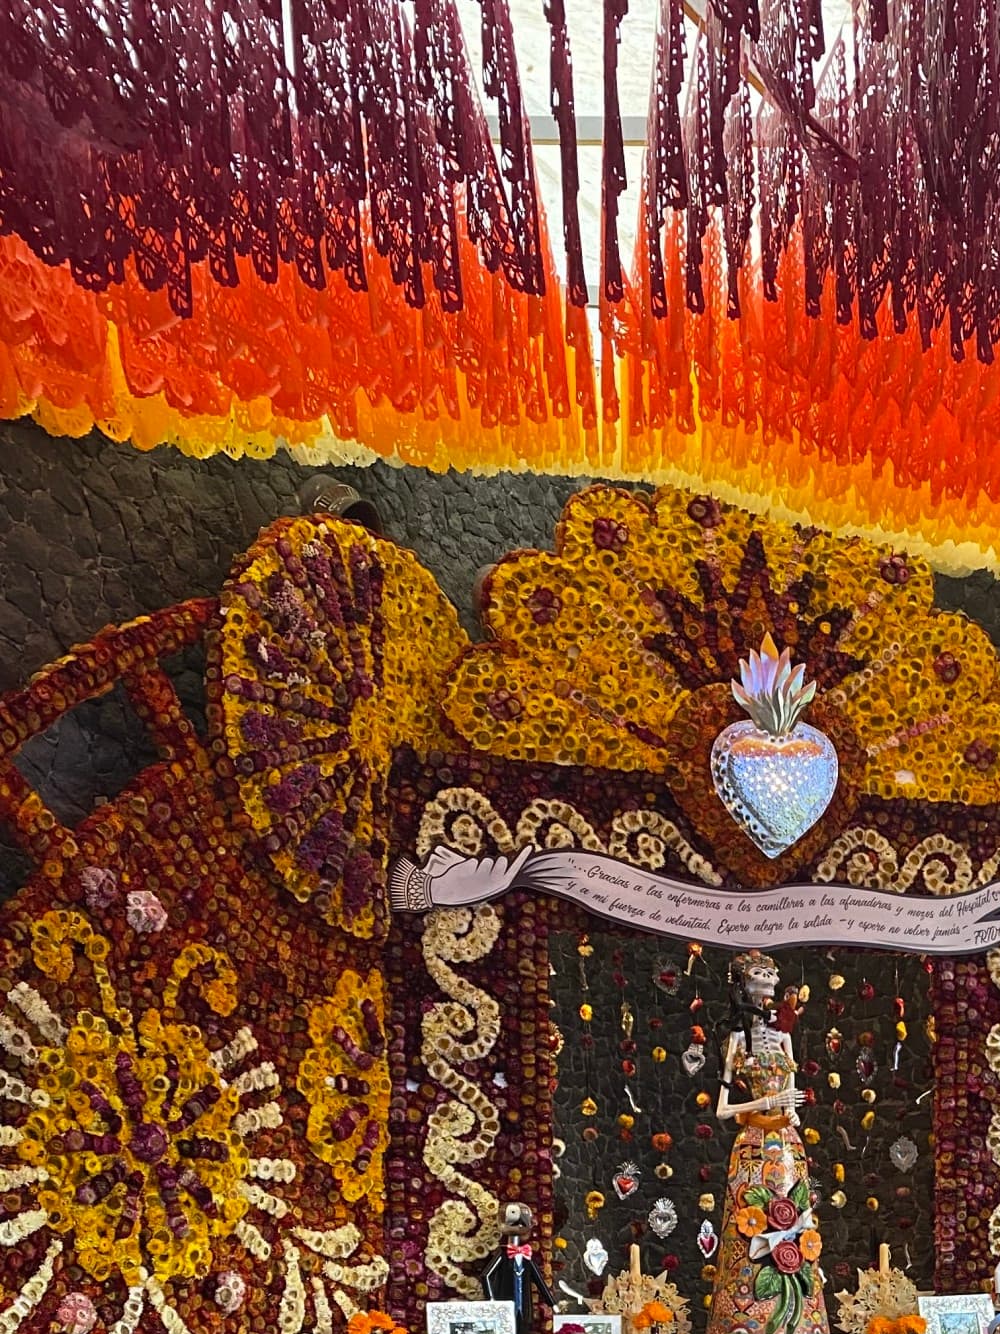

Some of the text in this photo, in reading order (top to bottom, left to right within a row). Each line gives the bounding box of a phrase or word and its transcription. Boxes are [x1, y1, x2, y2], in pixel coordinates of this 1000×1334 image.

[566, 881, 577, 891] y
[580, 887, 590, 895] a
[592, 893, 608, 904] mi
[609, 898, 646, 917] fuerza
[649, 910, 661, 920] de
[665, 917, 710, 930] voluntad.
[717, 918, 749, 935] Espero
[754, 920, 783, 935] alegre
[788, 917, 798, 929] la
[803, 914, 832, 928] salida
[859, 920, 886, 932] espero
[904, 924, 930, 936] volver
[646, 885, 664, 898] las
[667, 893, 721, 910] enfermeras
[725, 903, 733, 911] a
[737, 900, 750, 912] los
[756, 896, 804, 912] camilleros
[820, 894, 834, 906] las
[839, 895, 892, 911] afanadoras
[894, 906, 904, 916] y
[907, 909, 934, 921] mozos
[939, 904, 953, 918] del
[957, 889, 990, 916] Hospital
